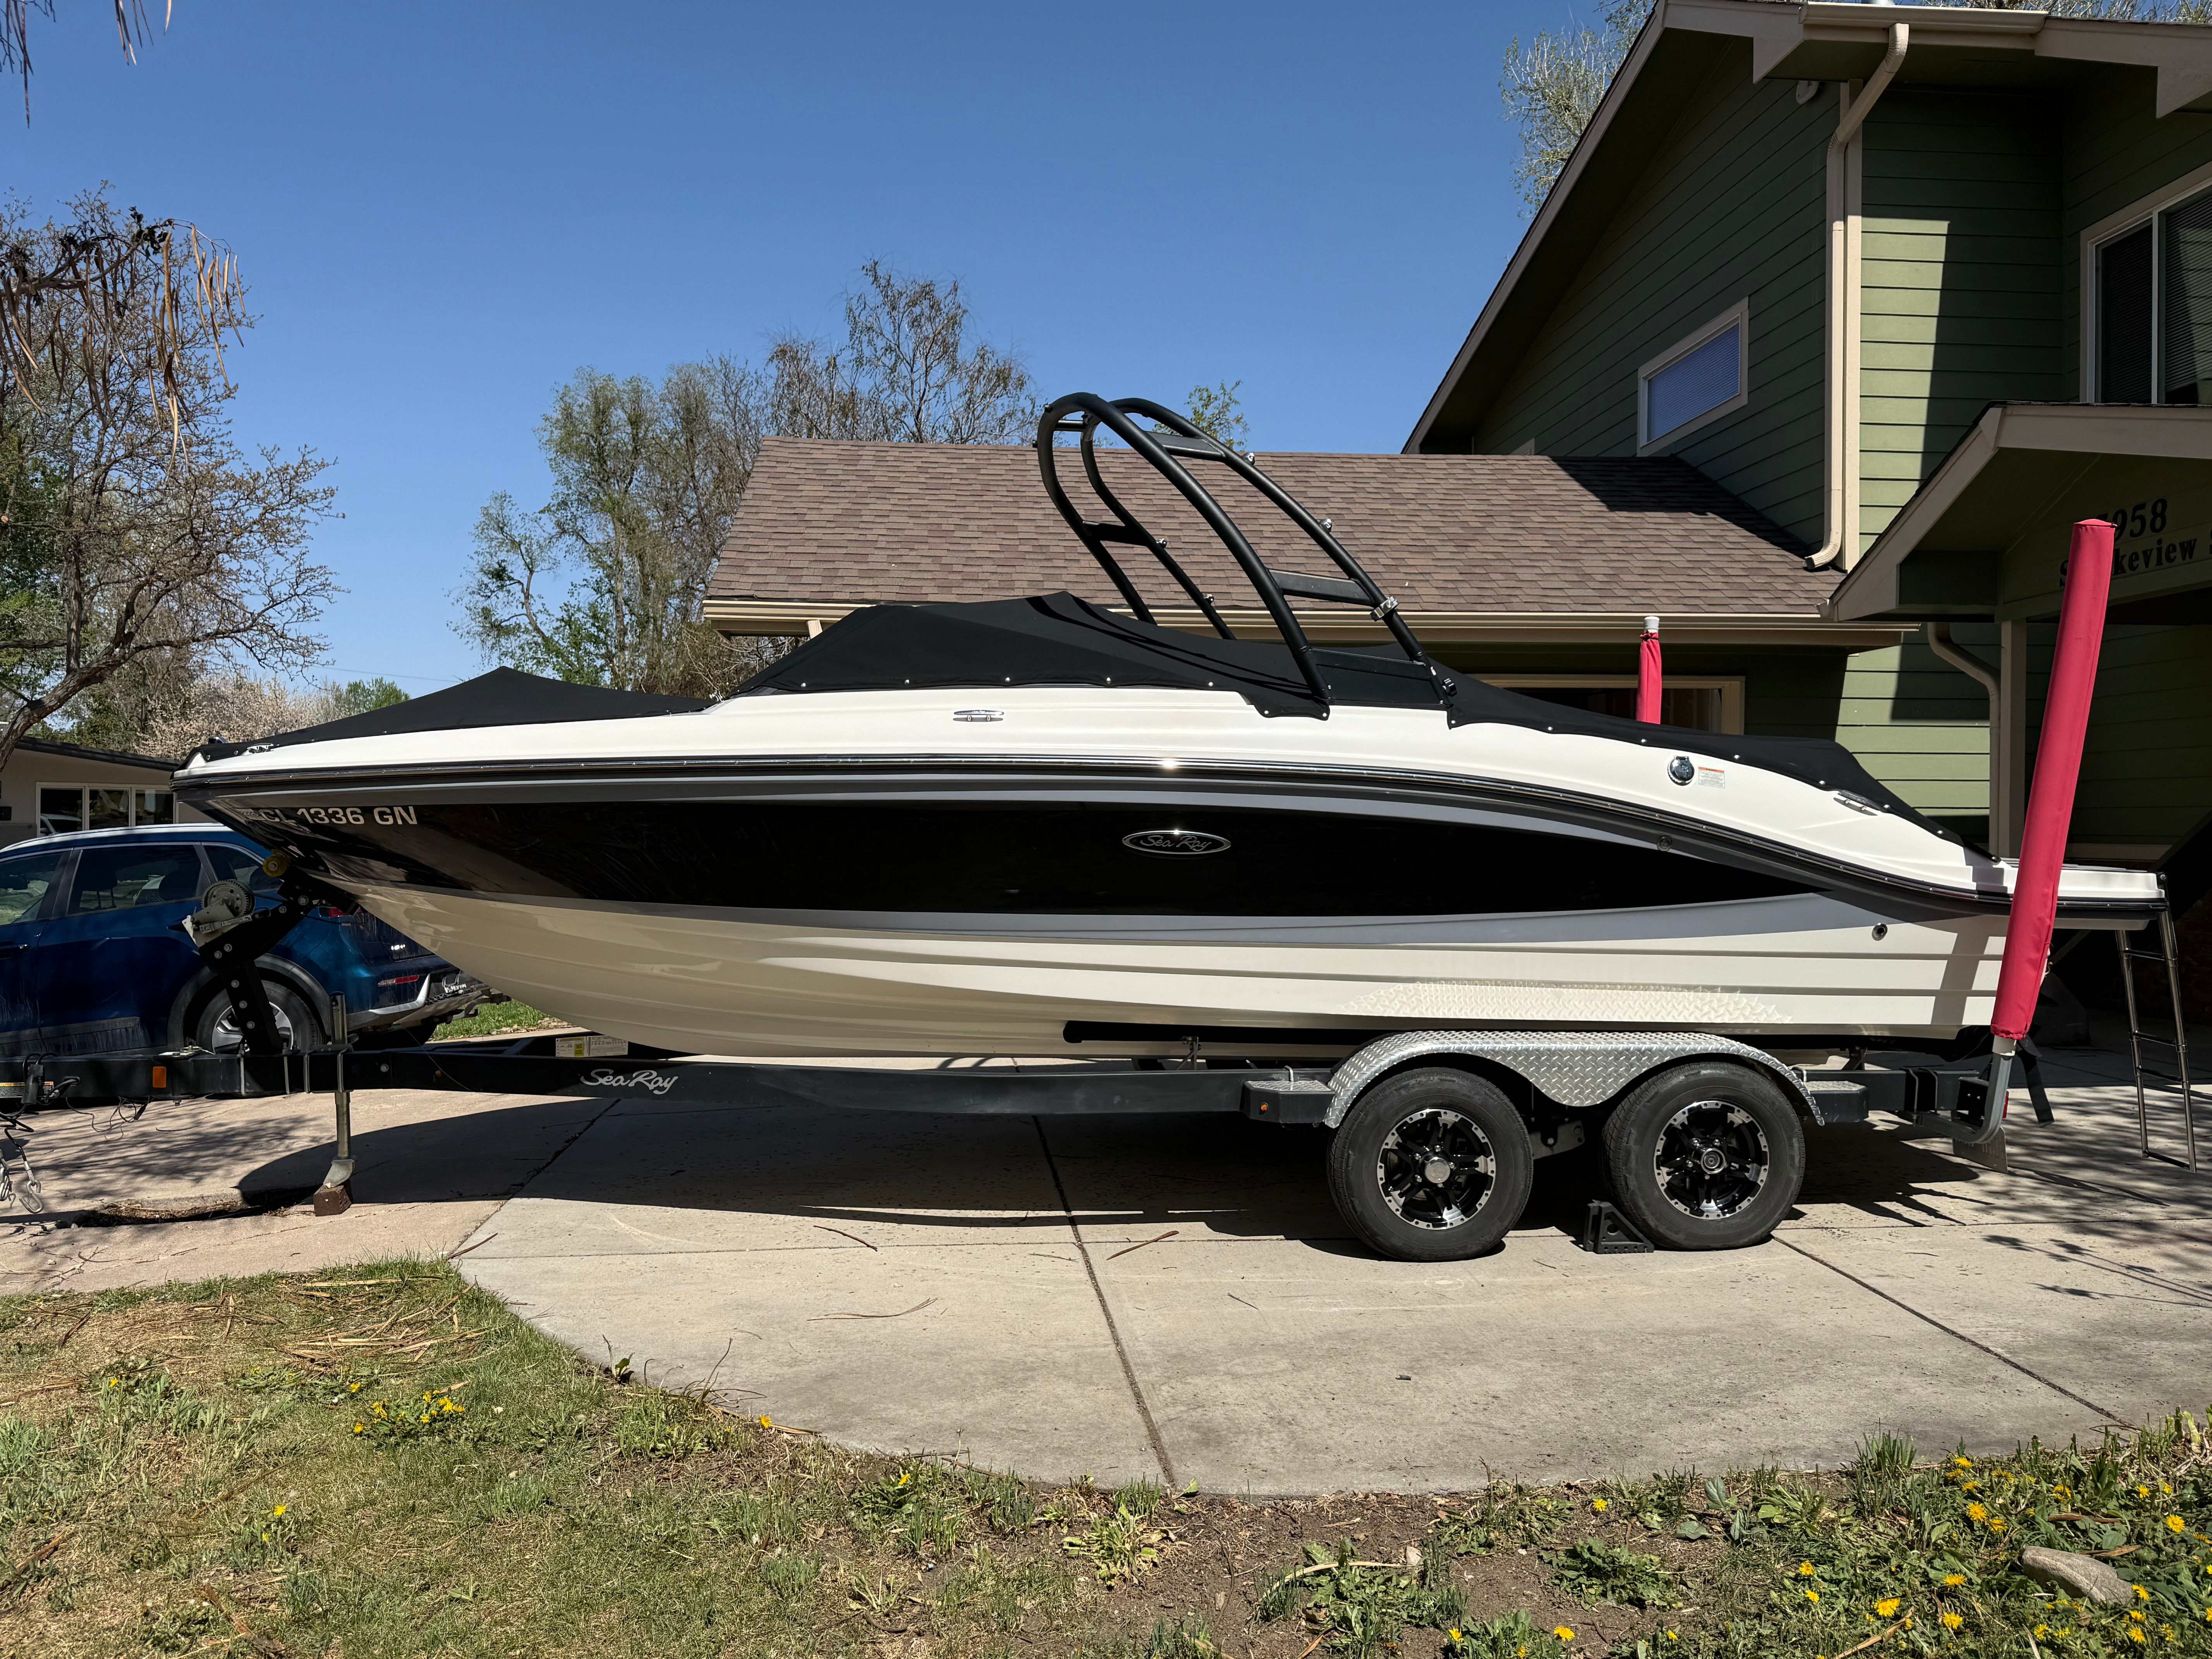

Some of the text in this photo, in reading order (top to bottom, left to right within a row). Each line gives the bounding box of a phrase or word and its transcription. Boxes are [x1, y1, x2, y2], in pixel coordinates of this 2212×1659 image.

[2097, 498, 2167, 543] 958
[258, 805, 417, 826] CL 1336 GN
[1140, 835, 1212, 851] Sea Ray
[580, 1068, 679, 1095] Sea Ray
